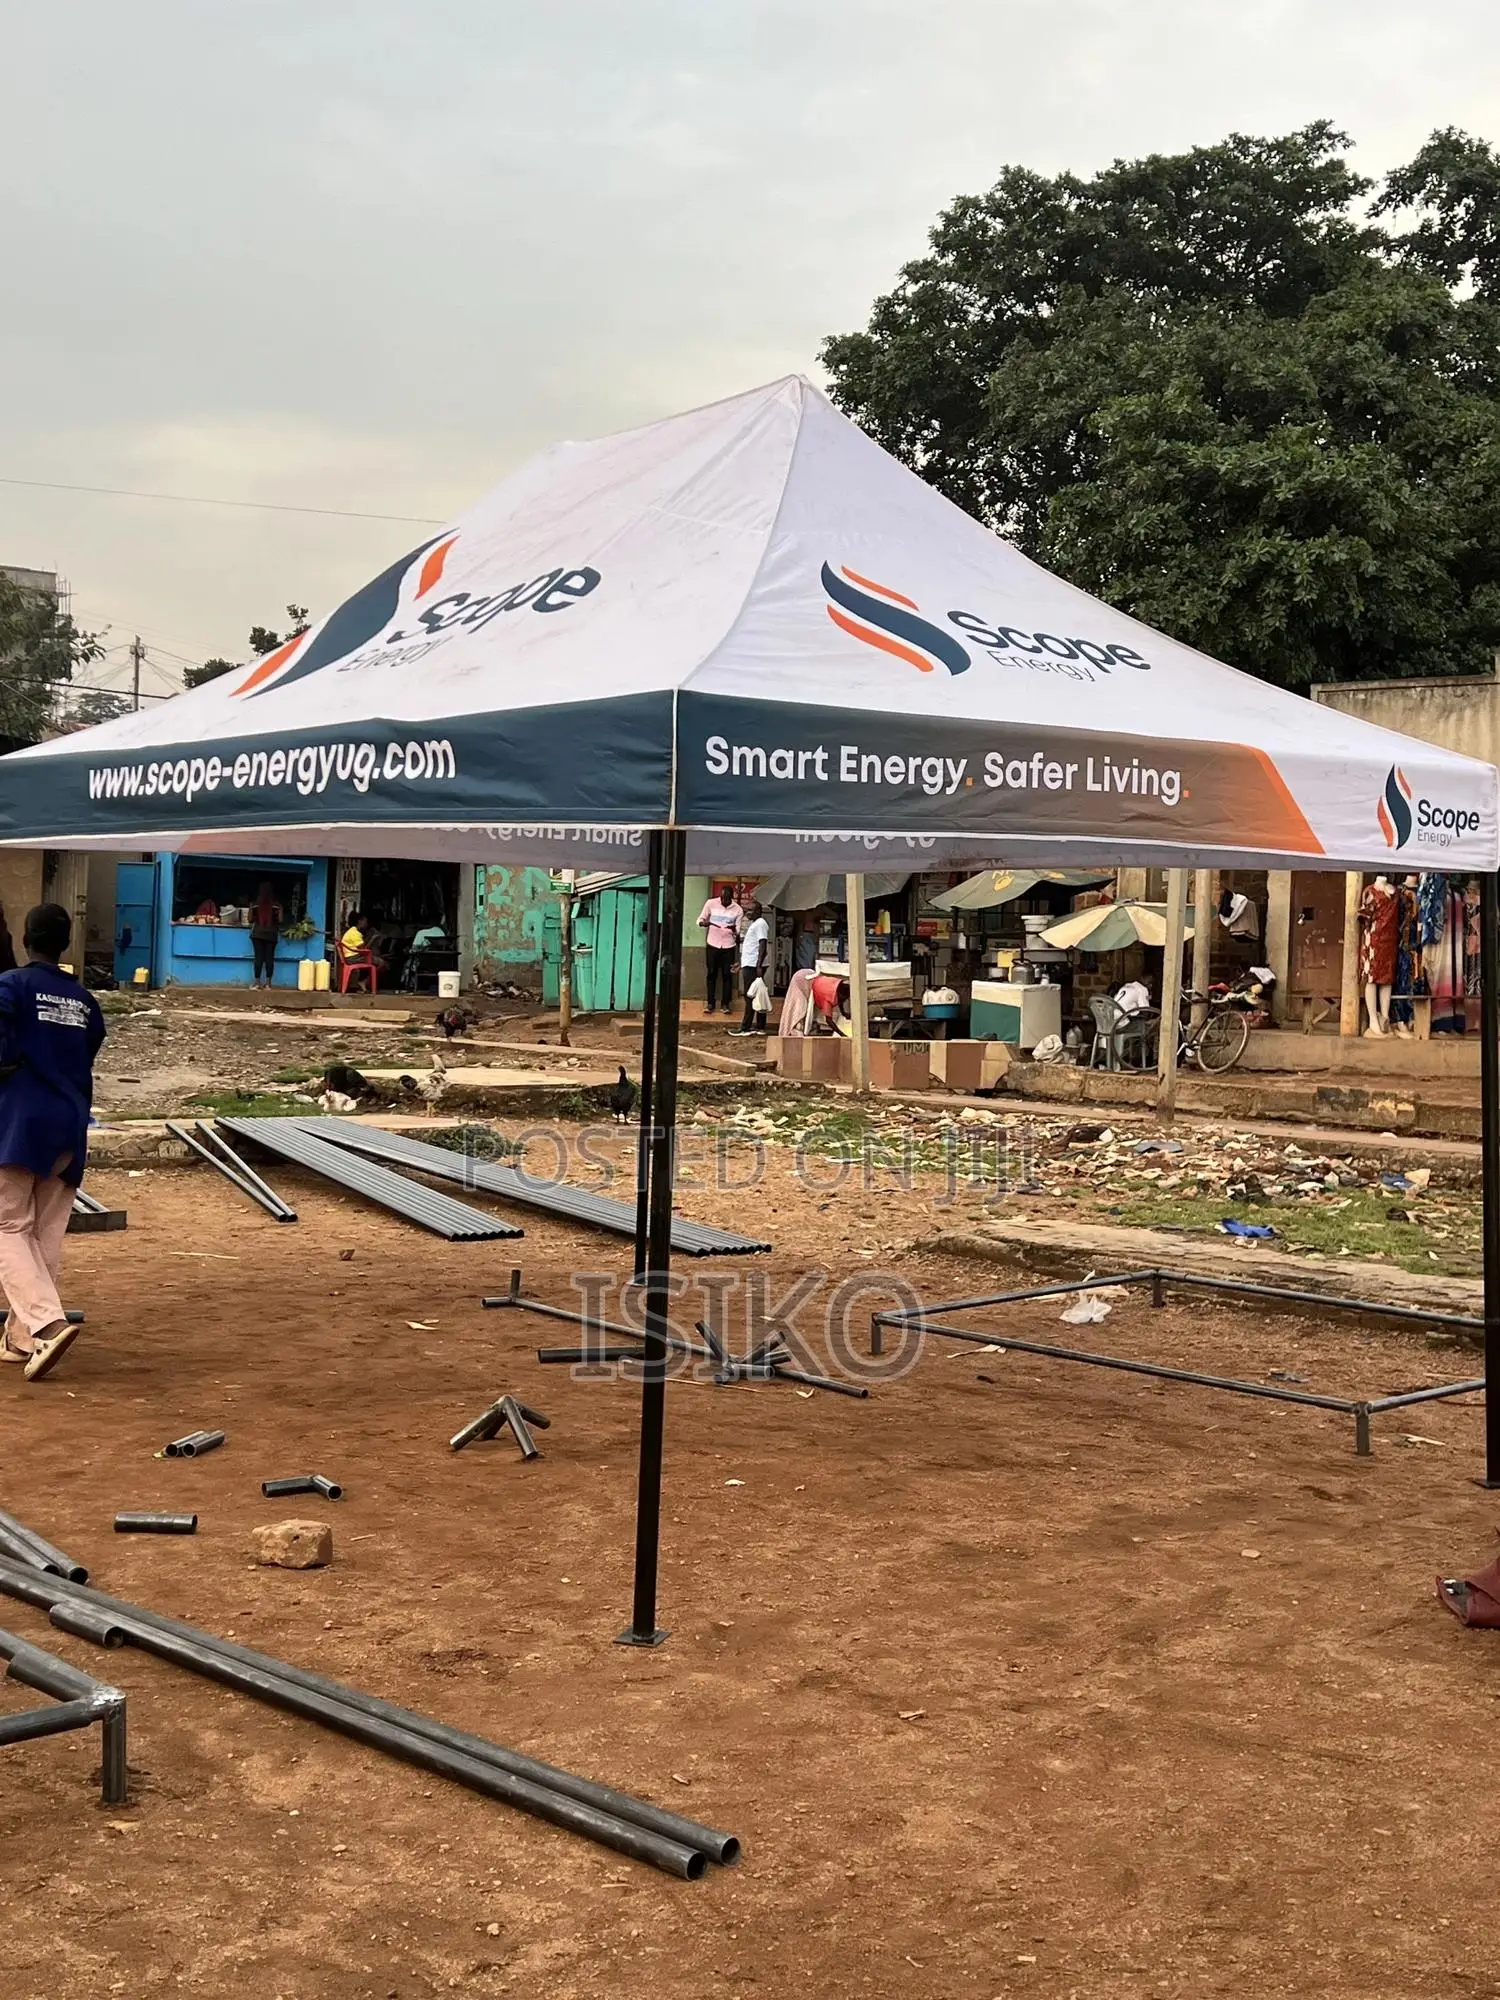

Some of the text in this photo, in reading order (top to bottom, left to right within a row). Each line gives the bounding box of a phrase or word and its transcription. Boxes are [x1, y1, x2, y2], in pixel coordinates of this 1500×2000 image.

[386, 566, 602, 644] Scope
[946, 610, 1152, 674] Scope
[986, 649, 1096, 682] Energy
[88, 738, 456, 803] www.scope-energyug.com
[705, 735, 1192, 807] Smart Energy. Safer Living.
[1417, 798, 1480, 838] Scope
[1417, 828, 1452, 847] Energy
